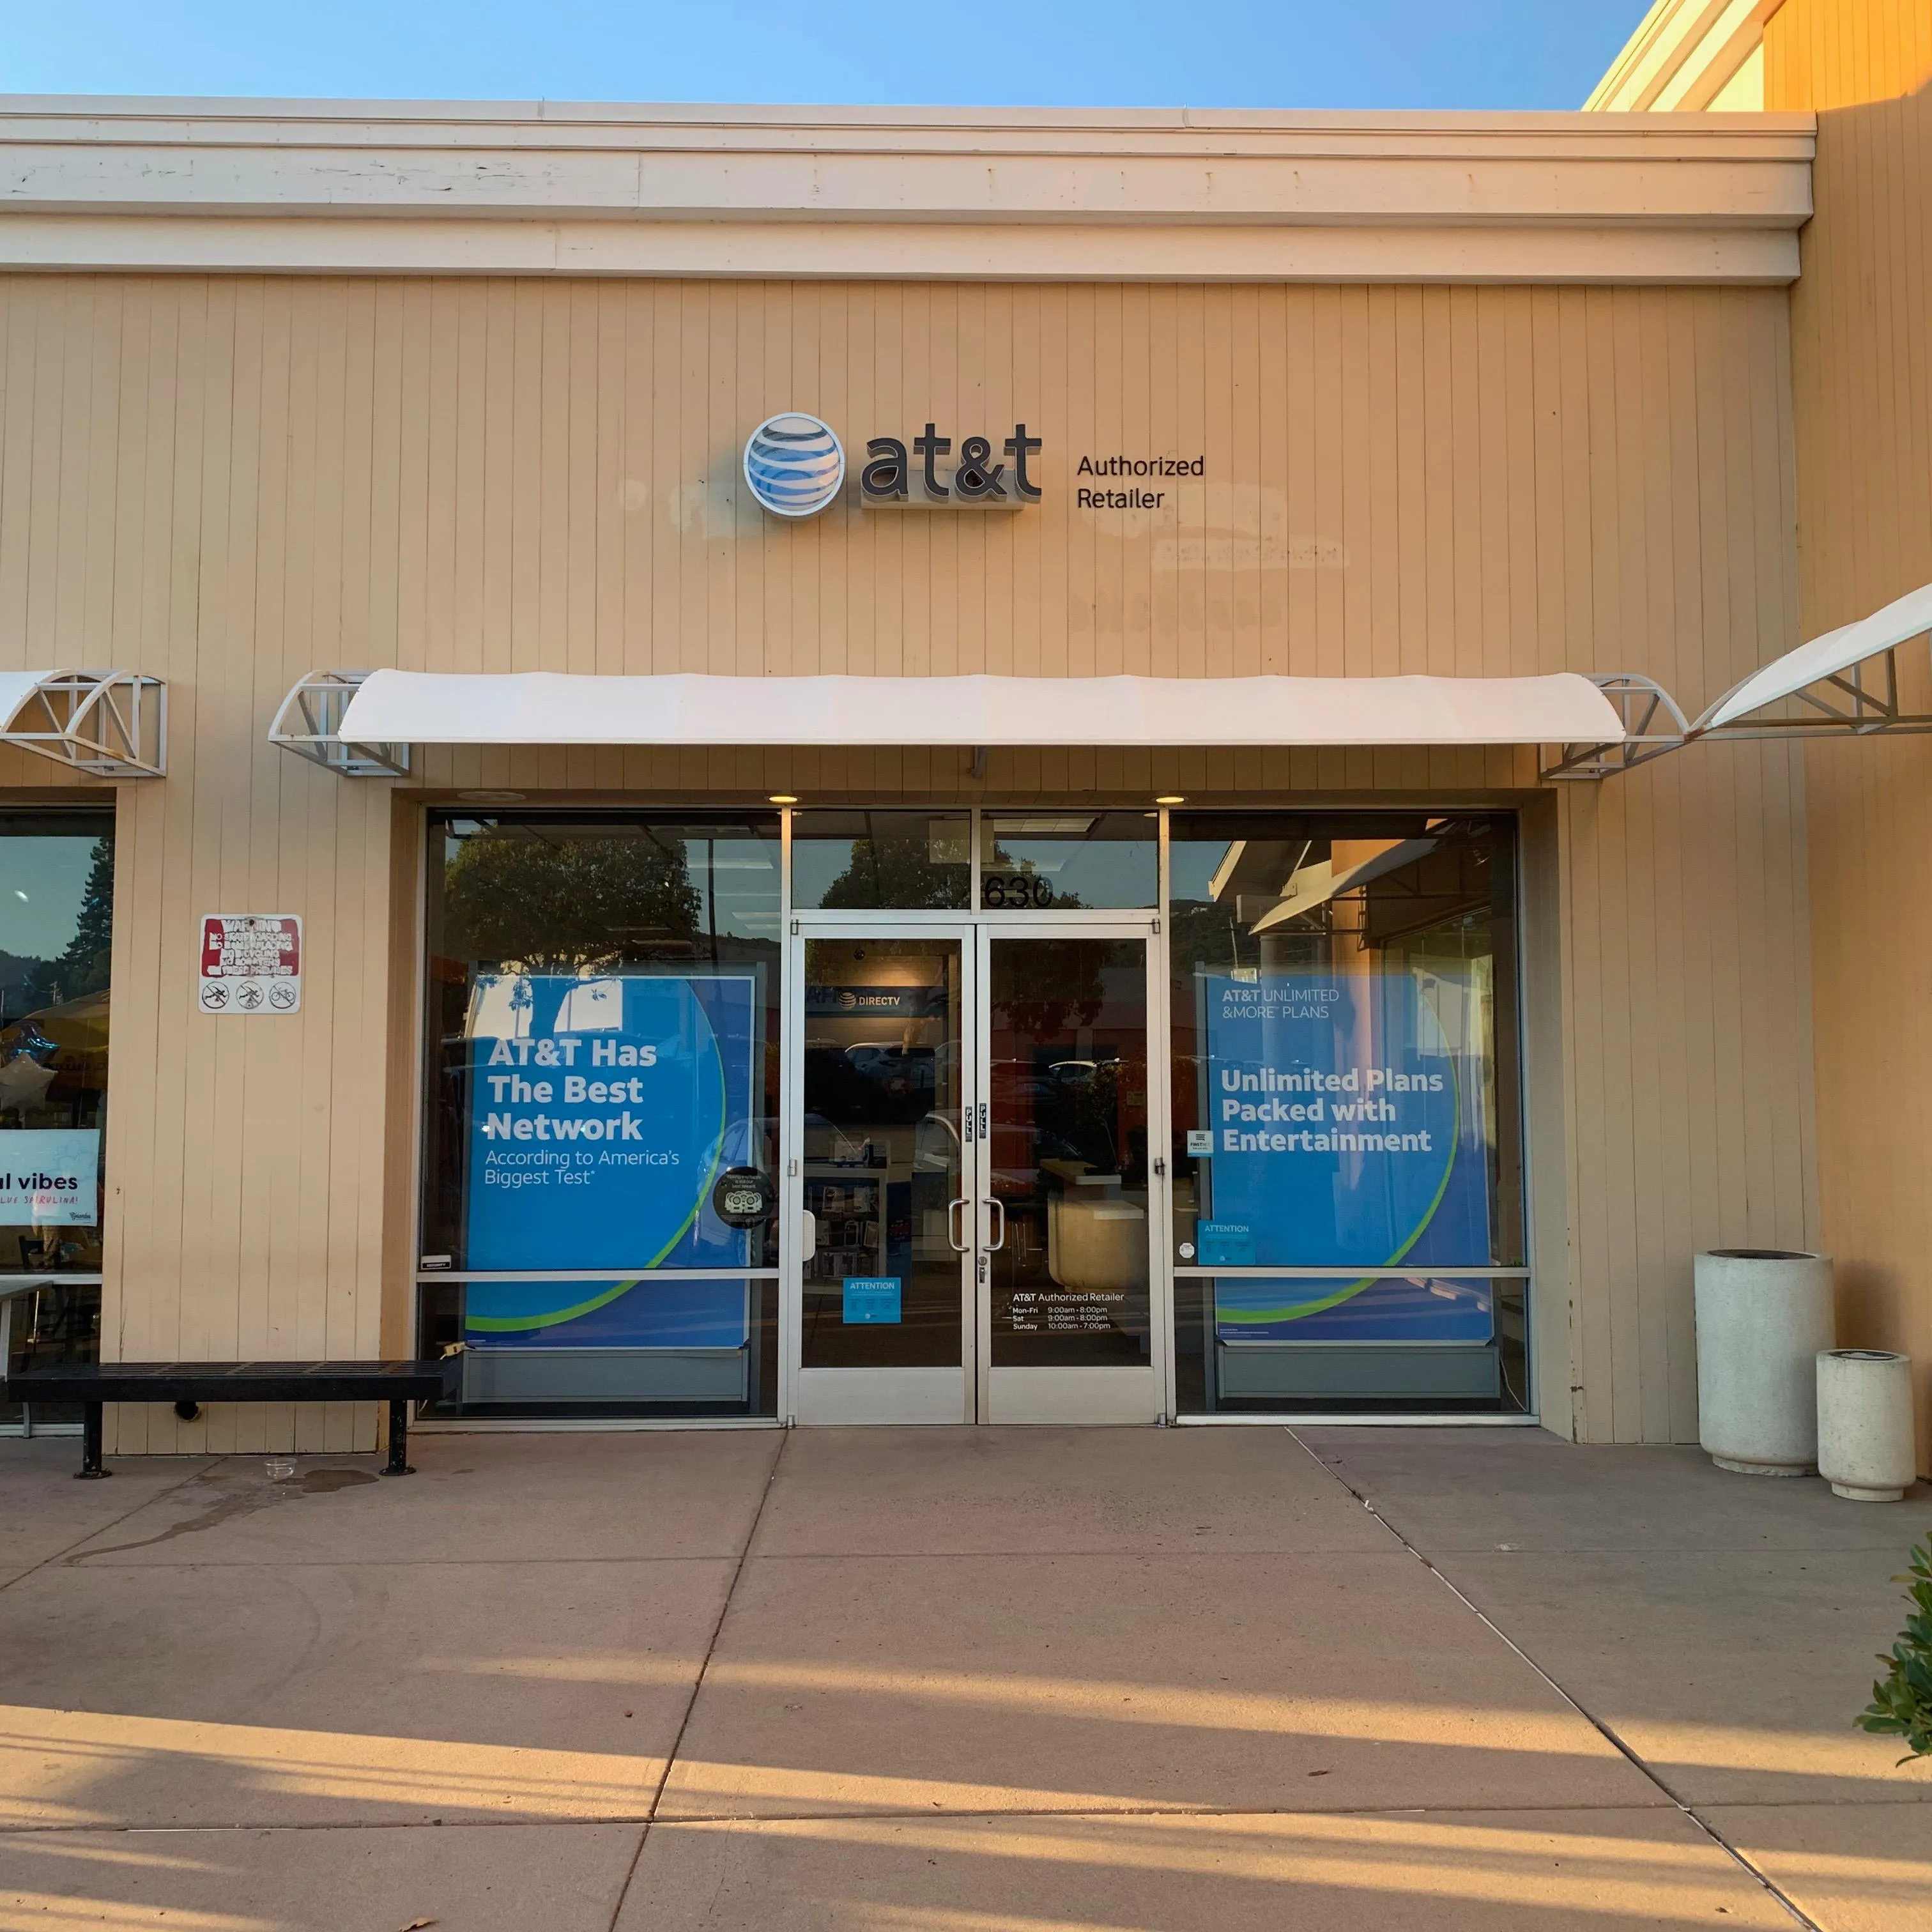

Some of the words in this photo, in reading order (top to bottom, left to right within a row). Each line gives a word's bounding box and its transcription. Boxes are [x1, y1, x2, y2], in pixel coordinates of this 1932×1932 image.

[861, 422, 1043, 499] at&t
[1077, 456, 1204, 476] Authorized
[1078, 487, 1165, 509] Retailer
[985, 876, 1054, 907] 630
[859, 997, 900, 1006] DIRECTV
[1223, 990, 1259, 1002] AT&T
[1263, 990, 1339, 1002] UNLIMITED
[1283, 1006, 1329, 1018] PLANS
[487, 1039, 582, 1066] AT&T
[592, 1039, 657, 1067] Has
[487, 1074, 553, 1103] The
[564, 1076, 643, 1103] Best
[1221, 1068, 1359, 1092] Unlimited
[1367, 1068, 1443, 1092] Plans
[1222, 1098, 1324, 1122] Packed
[1330, 1098, 1396, 1122] with
[487, 1111, 643, 1140] Network
[1223, 1128, 1432, 1151] Entertainment
[486, 1150, 570, 1169] According
[576, 1153, 594, 1165] to
[598, 1150, 679, 1165] America's
[18, 1172, 78, 1190] vibes
[485, 1169, 549, 1189] Biggest
[1013, 1293, 1036, 1301] AT&T
[1038, 1293, 1088, 1301] Authorized
[1090, 1293, 1124, 1301] Retailer
